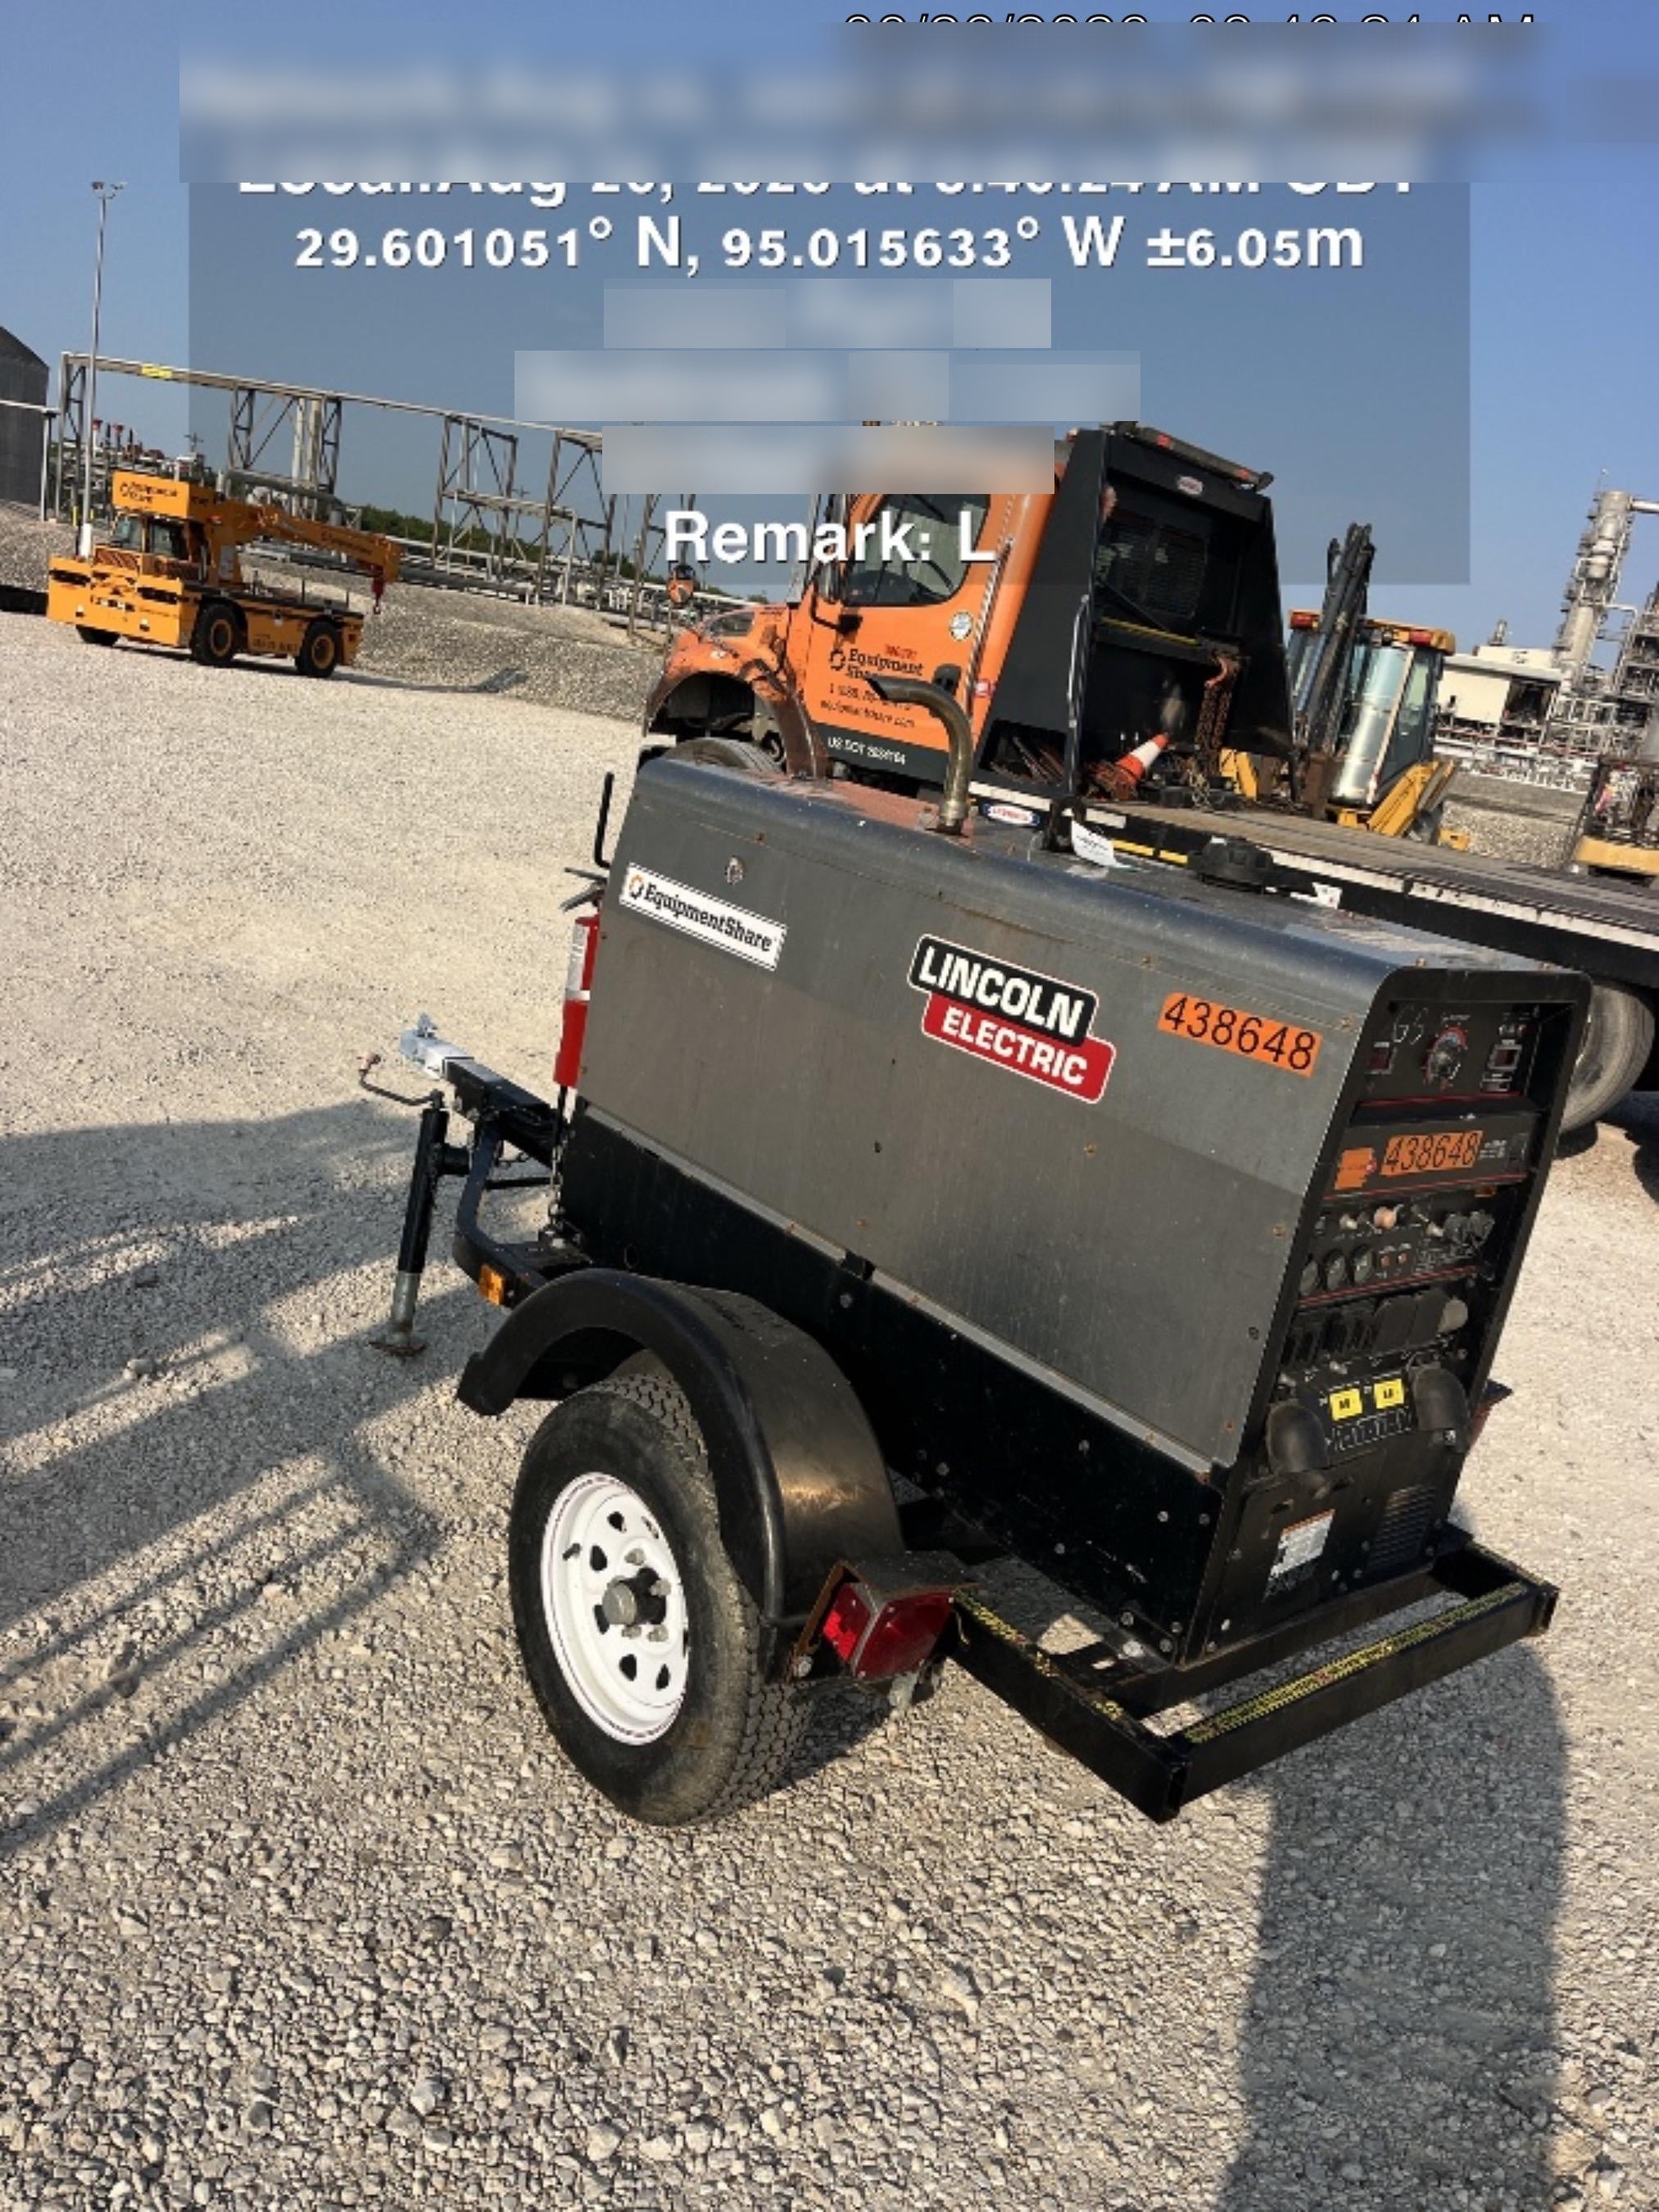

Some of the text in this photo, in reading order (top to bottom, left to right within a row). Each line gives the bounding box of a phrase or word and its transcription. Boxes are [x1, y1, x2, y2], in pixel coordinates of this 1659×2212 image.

[849, 648, 923, 676] Equipment
[643, 881, 773, 952] EquipmentShare
[918, 945, 1085, 1038] LINCOLN
[942, 1007, 1088, 1086] ELECTRIC
[1163, 996, 1317, 1069] 438648
[1385, 1131, 1481, 1172] 438648
